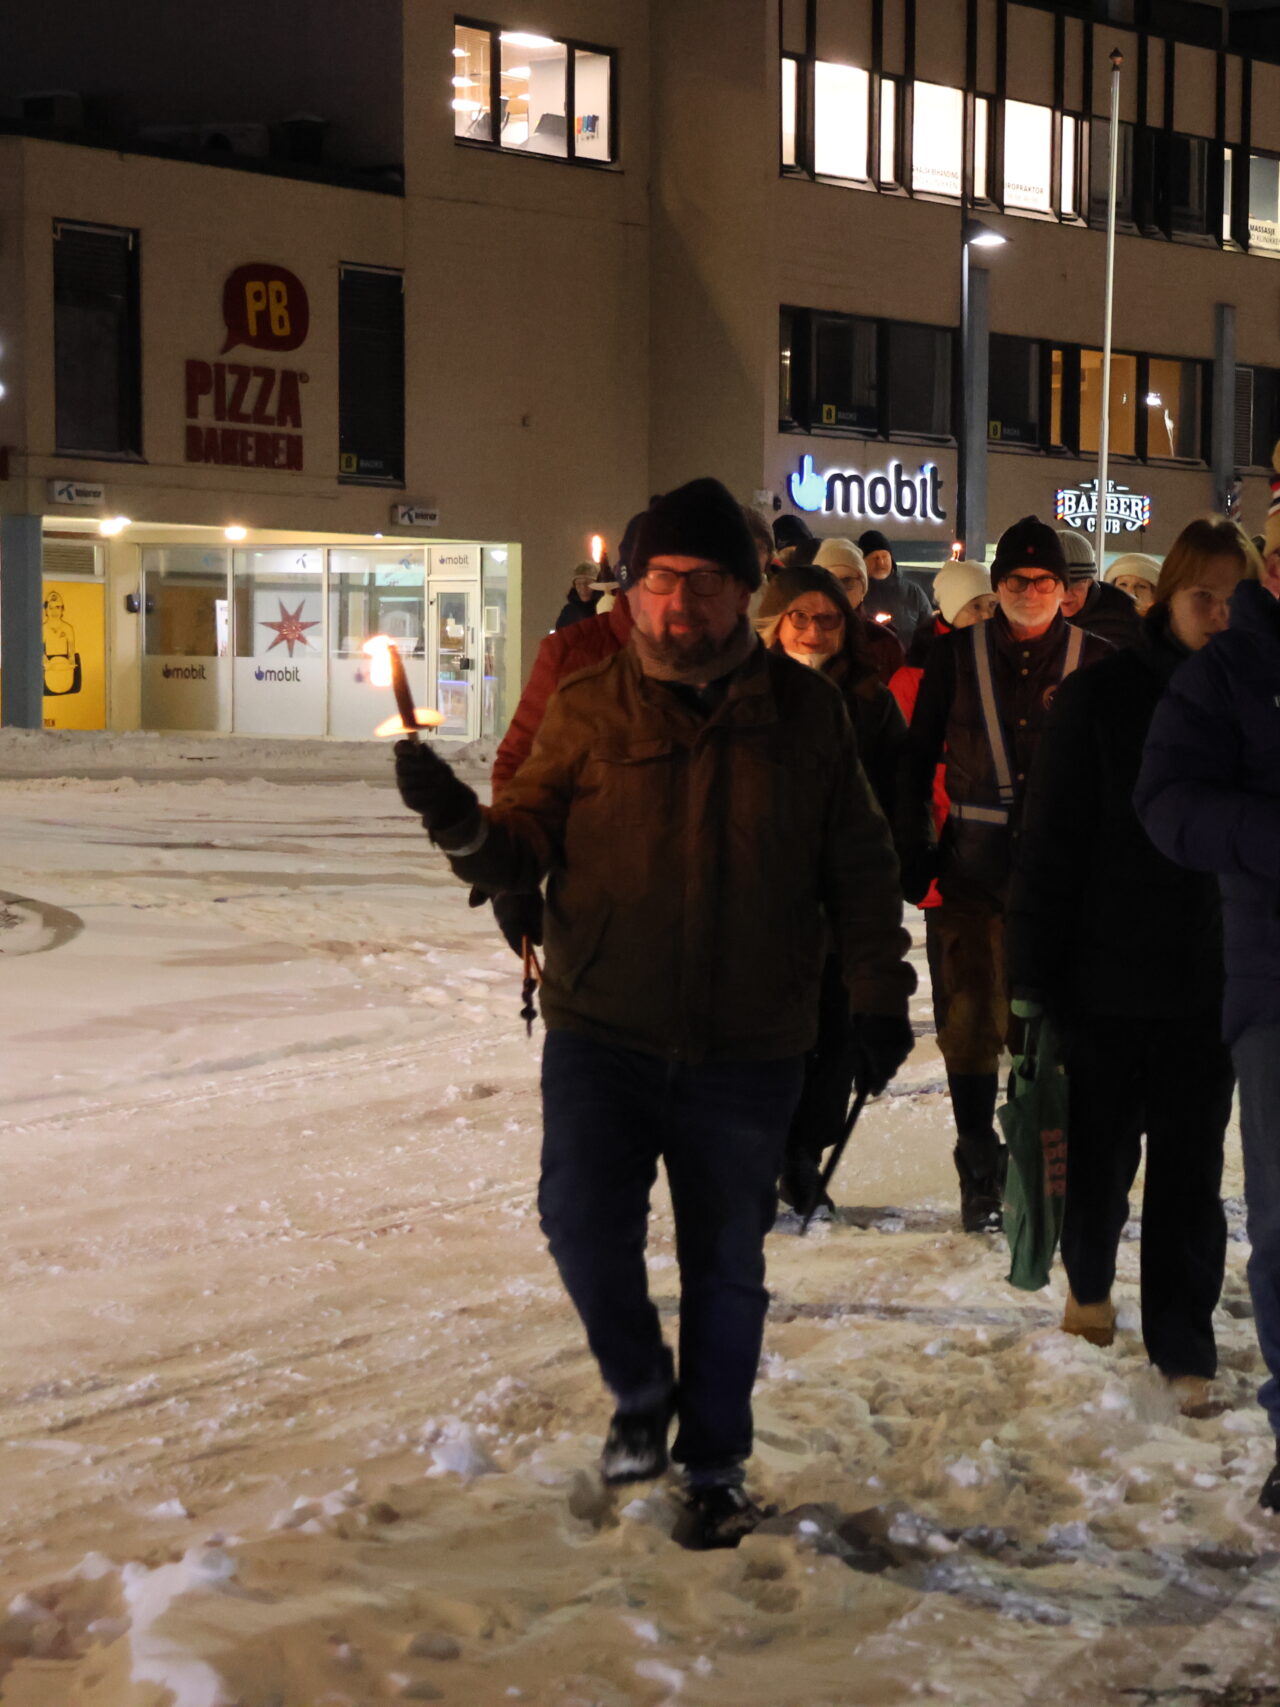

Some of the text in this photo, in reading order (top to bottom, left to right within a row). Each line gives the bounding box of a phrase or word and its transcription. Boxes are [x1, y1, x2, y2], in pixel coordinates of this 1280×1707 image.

[244, 279, 291, 338] PB
[825, 461, 948, 521] mobit
[1093, 478, 1115, 493] TE
[1086, 516, 1121, 534] CUB
[445, 554, 470, 565] mobit
[172, 664, 207, 680] mobit
[263, 666, 301, 682] mobit
